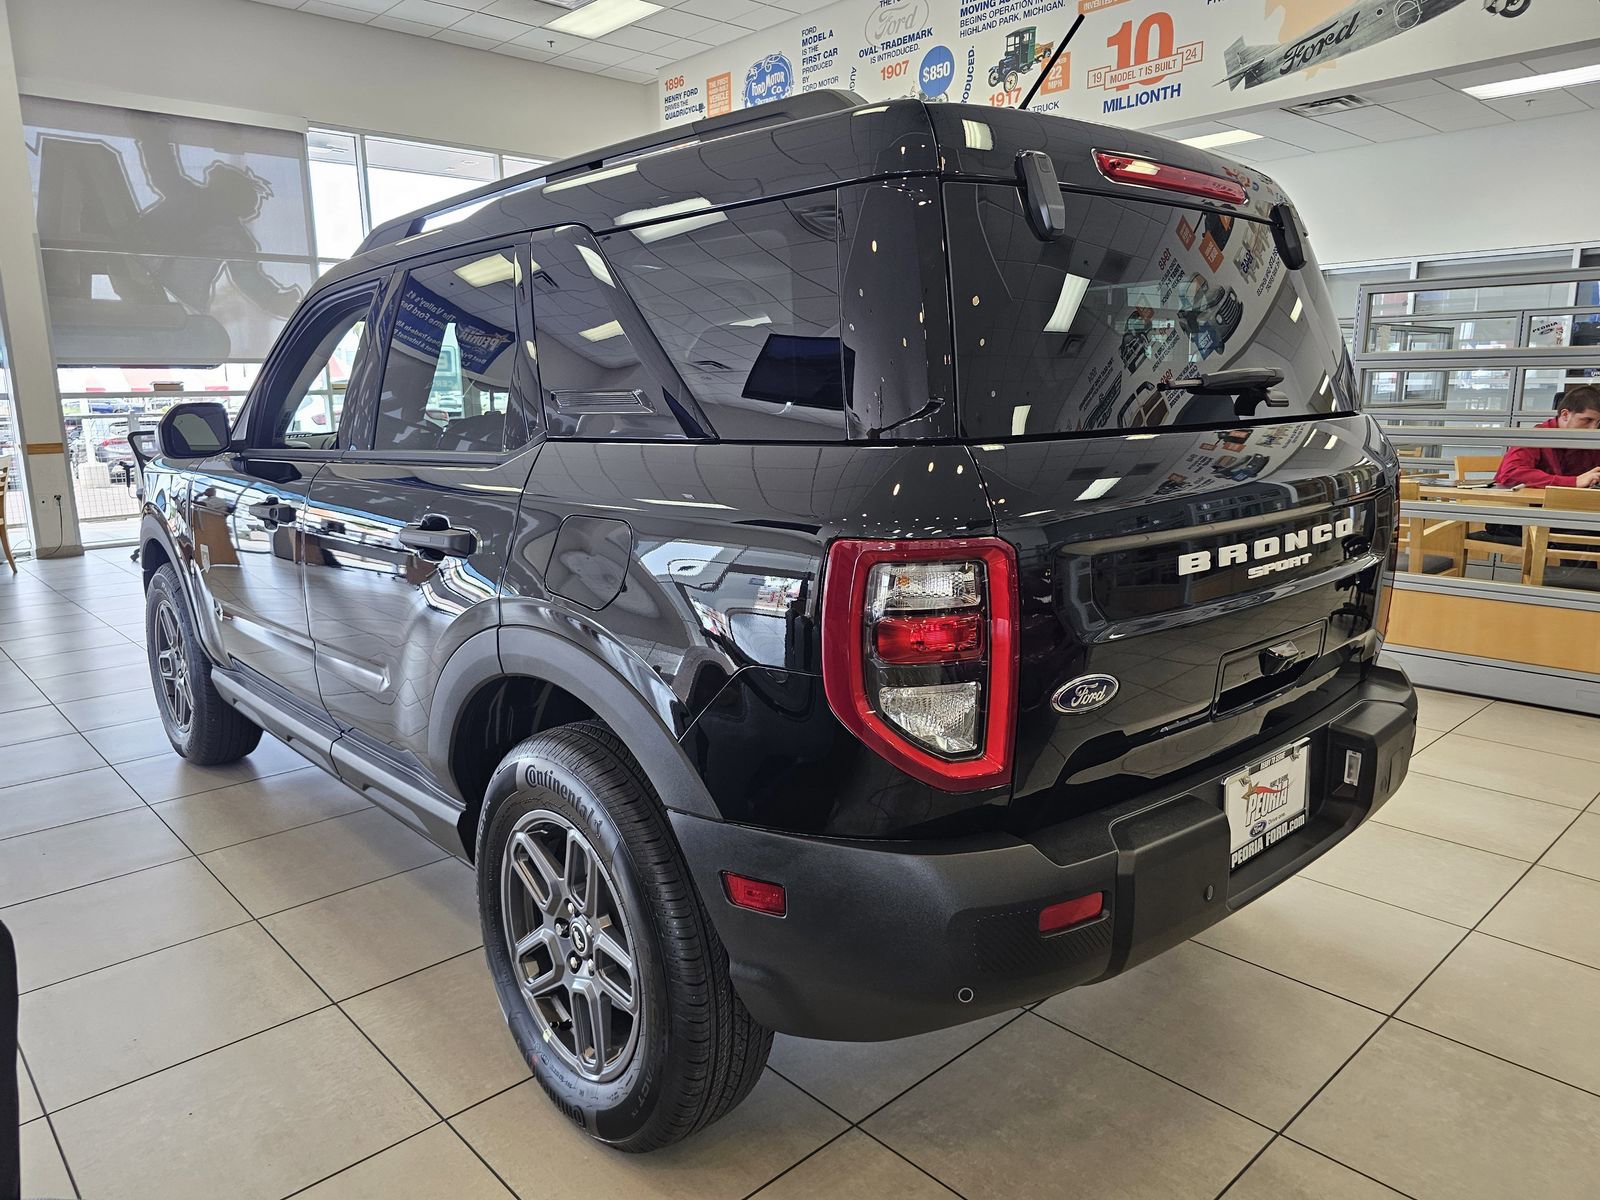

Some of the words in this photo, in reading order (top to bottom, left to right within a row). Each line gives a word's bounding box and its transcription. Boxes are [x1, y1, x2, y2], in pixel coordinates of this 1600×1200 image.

[960, 0, 996, 17] MOVING
[960, 10, 987, 28] BEGINS
[988, 0, 1034, 19] OPERATION
[960, 20, 997, 38] HIGHLAND
[998, 13, 1022, 26] PARK,
[1023, 0, 1066, 19] MICHIGAN.
[801, 25, 817, 37] FORD
[874, 2, 918, 39] Ford
[801, 31, 827, 47] MODEL
[828, 29, 834, 38] A
[808, 44, 819, 54] THE
[858, 45, 878, 58] OVAL
[880, 27, 933, 51] TRADEMARK
[1279, 12, 1361, 75] Ford
[802, 53, 821, 66] FIRST
[823, 47, 838, 59] CAR
[870, 54, 877, 64] IS
[877, 44, 920, 63] INTRODUCED.
[1106, 11, 1174, 92] 10
[1184, 48, 1198, 61] 24
[802, 59, 833, 75] PRODUCED
[880, 60, 910, 81] 1907
[922, 60, 951, 83] $850
[1092, 71, 1102, 84] 19
[1109, 69, 1136, 84] MODEL
[1138, 68, 1144, 80] T
[1145, 65, 1153, 77] IS
[1154, 58, 1177, 75] BUILT
[664, 75, 685, 91] 1896
[818, 76, 839, 88] MOTOR
[849, 66, 857, 91] AUG
[664, 92, 682, 104] HENRY
[683, 87, 699, 98] FORD
[988, 87, 1022, 107] 1917
[1032, 100, 1060, 113] TRUCK
[1103, 83, 1182, 114] MILLIONTH
[1178, 517, 1353, 577] BRONCO
[1247, 552, 1312, 579] SPORT
[1070, 682, 1107, 708] Ford
[524, 764, 595, 827] Continental
[1231, 836, 1264, 869] PEORIA
